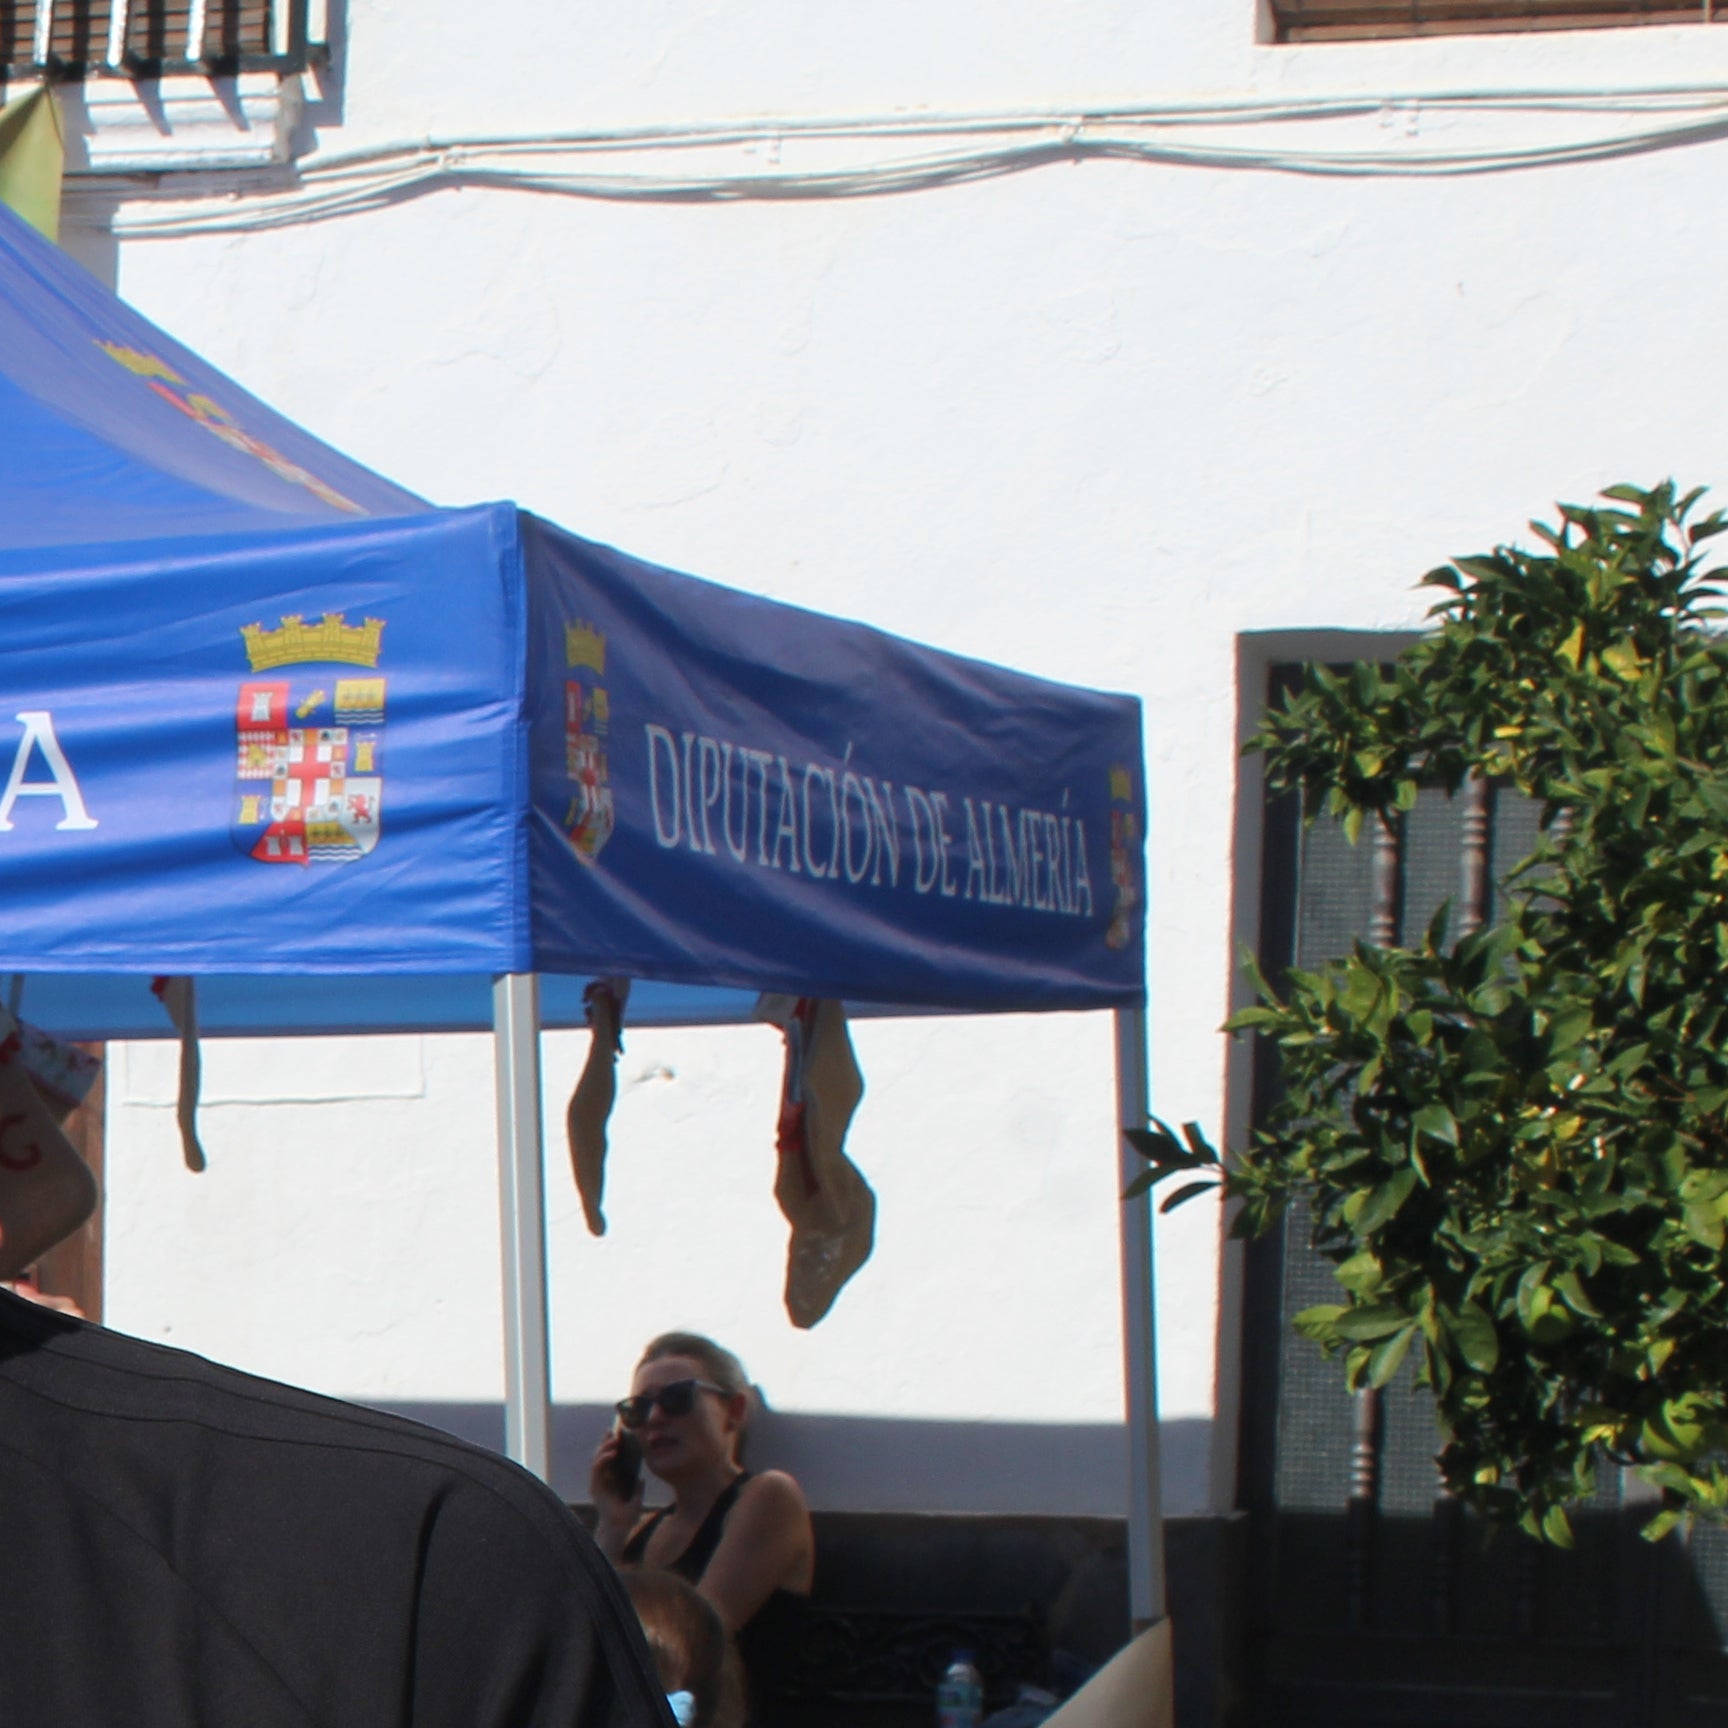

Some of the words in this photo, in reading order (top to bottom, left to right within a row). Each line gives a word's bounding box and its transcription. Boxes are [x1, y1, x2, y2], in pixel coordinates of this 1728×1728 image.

[645, 723, 901, 888] DIPUTACIÓN
[905, 785, 956, 897] DE
[964, 788, 1094, 917] ALMERÍA
